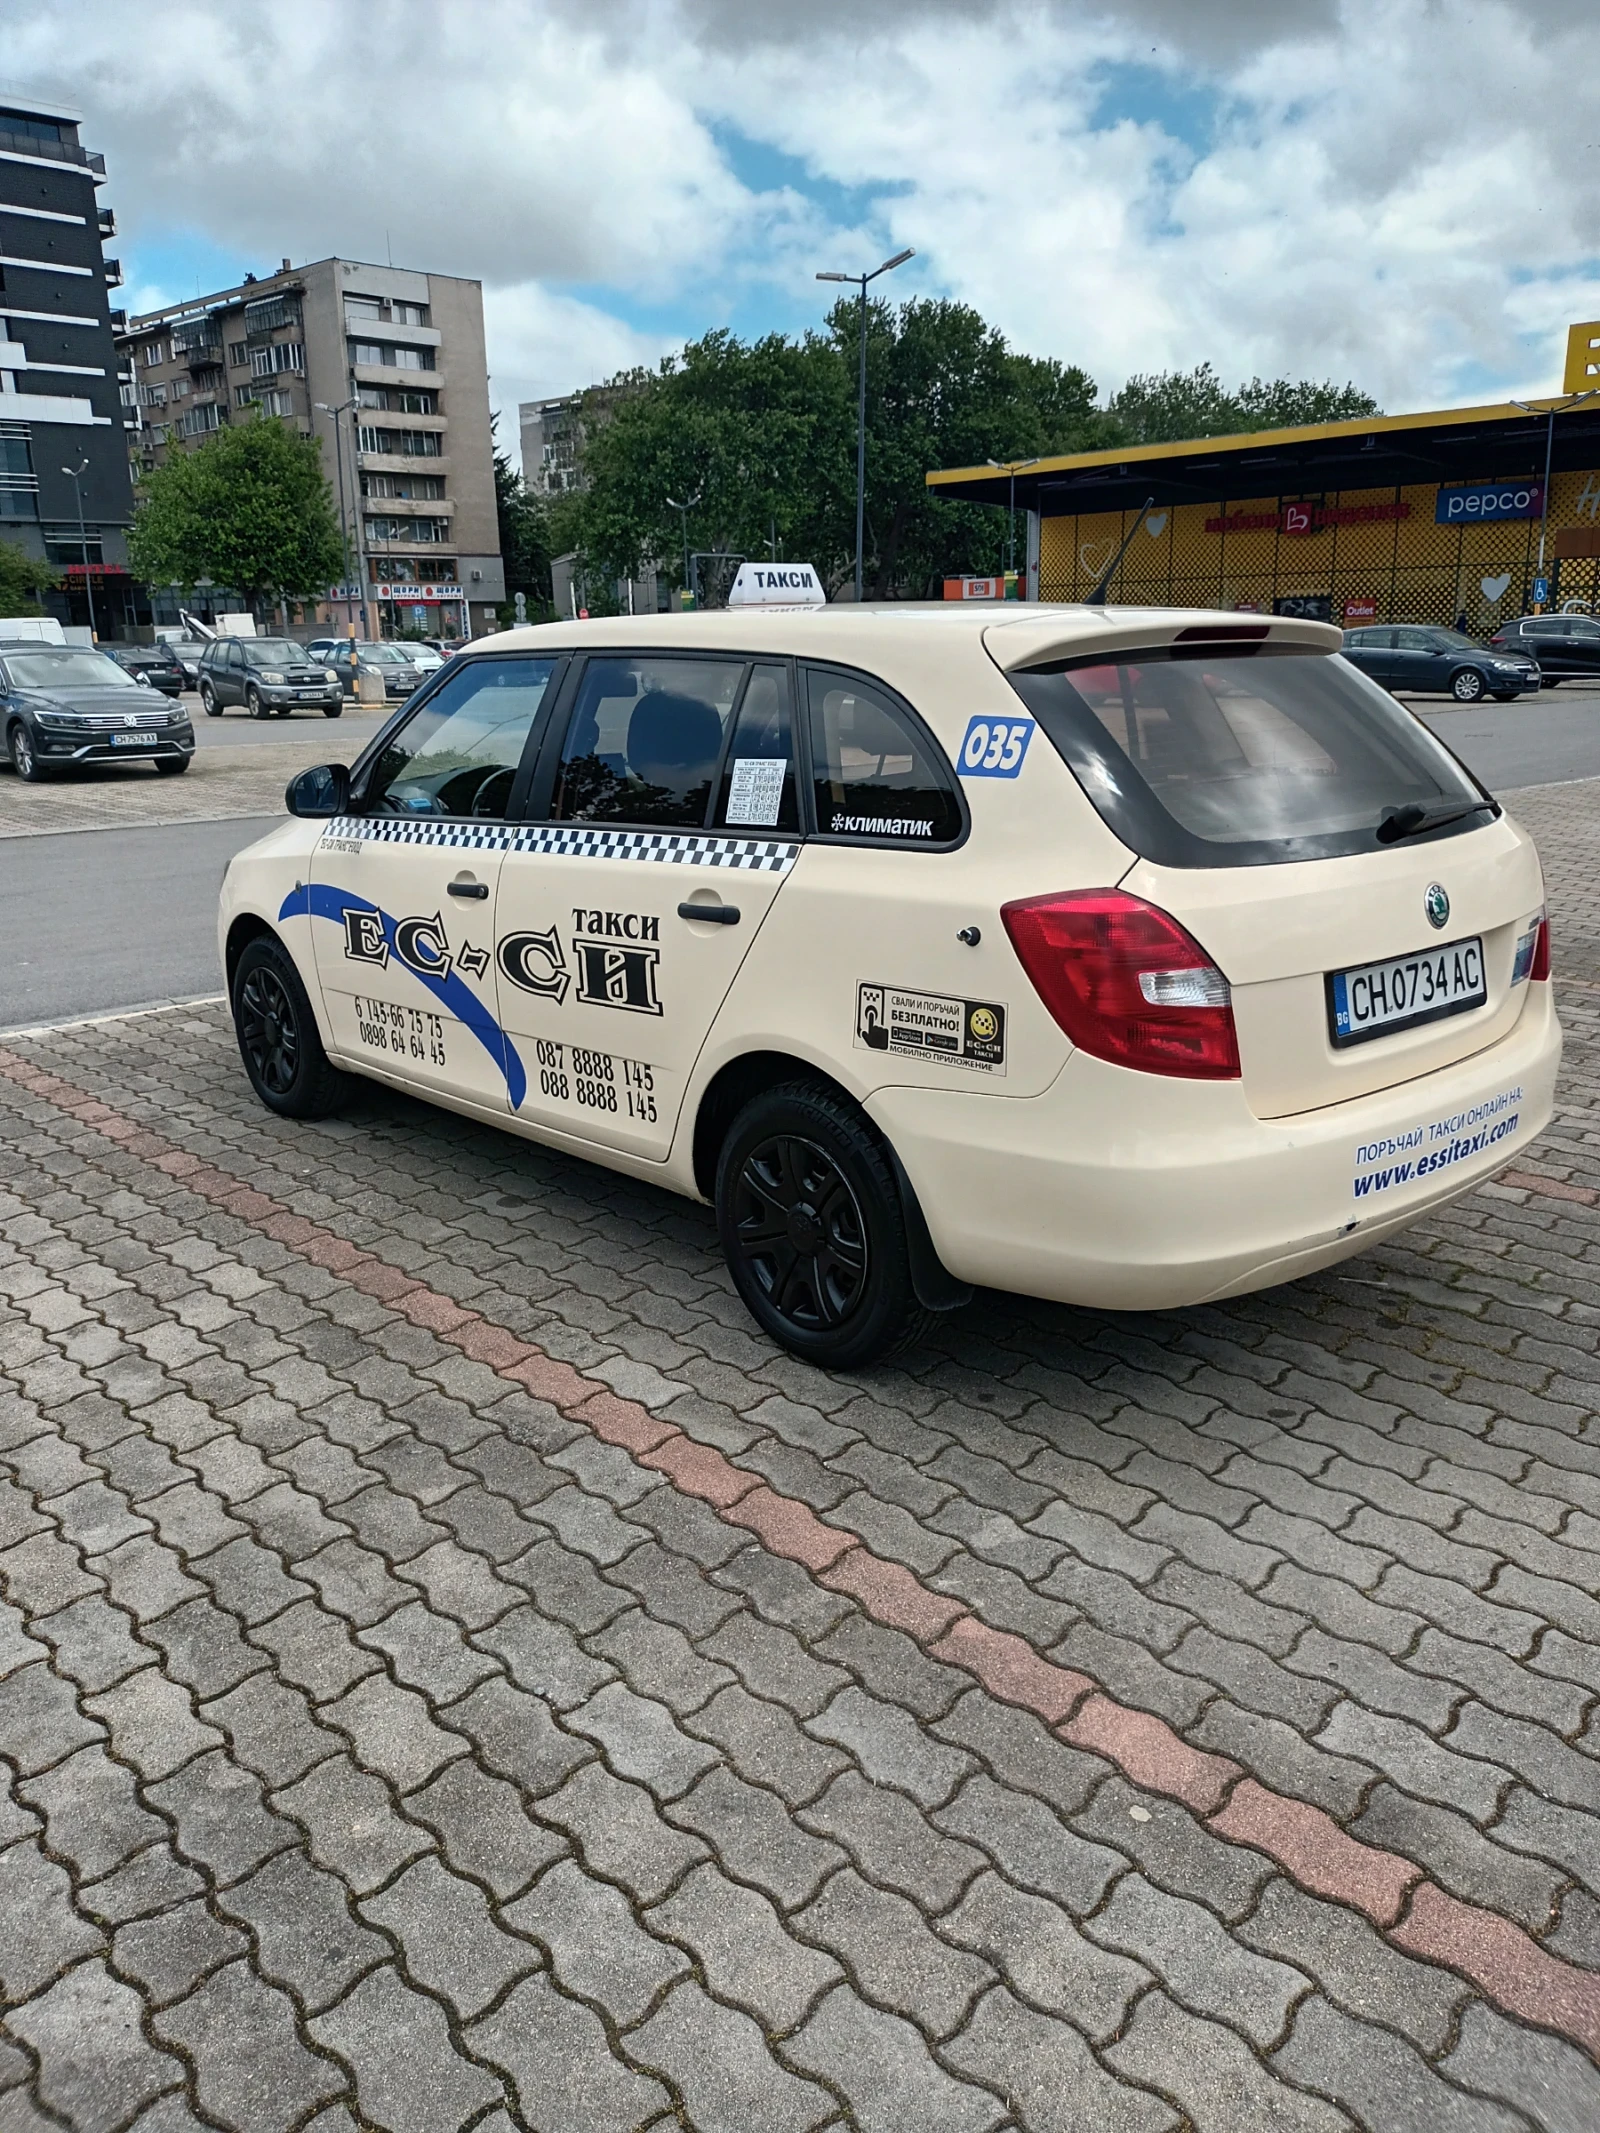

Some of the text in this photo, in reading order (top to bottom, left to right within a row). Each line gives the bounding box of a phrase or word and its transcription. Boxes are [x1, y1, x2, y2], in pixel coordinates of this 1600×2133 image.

[68, 564, 126, 574] HOTEL
[69, 575, 104, 584] CIRLE
[753, 571, 813, 588] ТАКСИ
[1346, 606, 1374, 616] Outlet
[964, 723, 1028, 771] 035
[1352, 971, 1388, 1021] CH
[1392, 956, 1447, 1010] 0734
[1454, 948, 1479, 994] AC
[355, 996, 363, 1018] 6
[408, 1009, 423, 1033] 75
[427, 1013, 443, 1038] 75
[891, 996, 960, 1016] СВАЛИ И ПОРЪЧАЙ
[891, 1010, 960, 1032] БЕЗПЛАТНО!
[1336, 1011, 1349, 1026] BG
[360, 1021, 445, 1066] 0898 64 64 45
[890, 1045, 994, 1071] МОБИЛНО ПРИЛОЖЕНИЕ
[536, 1040, 654, 1091] 087 8888 145
[541, 1069, 657, 1123] 088 8888 145
[1356, 1127, 1423, 1165] ПОРЪЧАЙ
[1429, 1114, 1464, 1140] ТАКСИ
[1467, 1094, 1508, 1124] ОНЛАЙН
[1354, 1113, 1519, 1198] www.essitaxi.com
